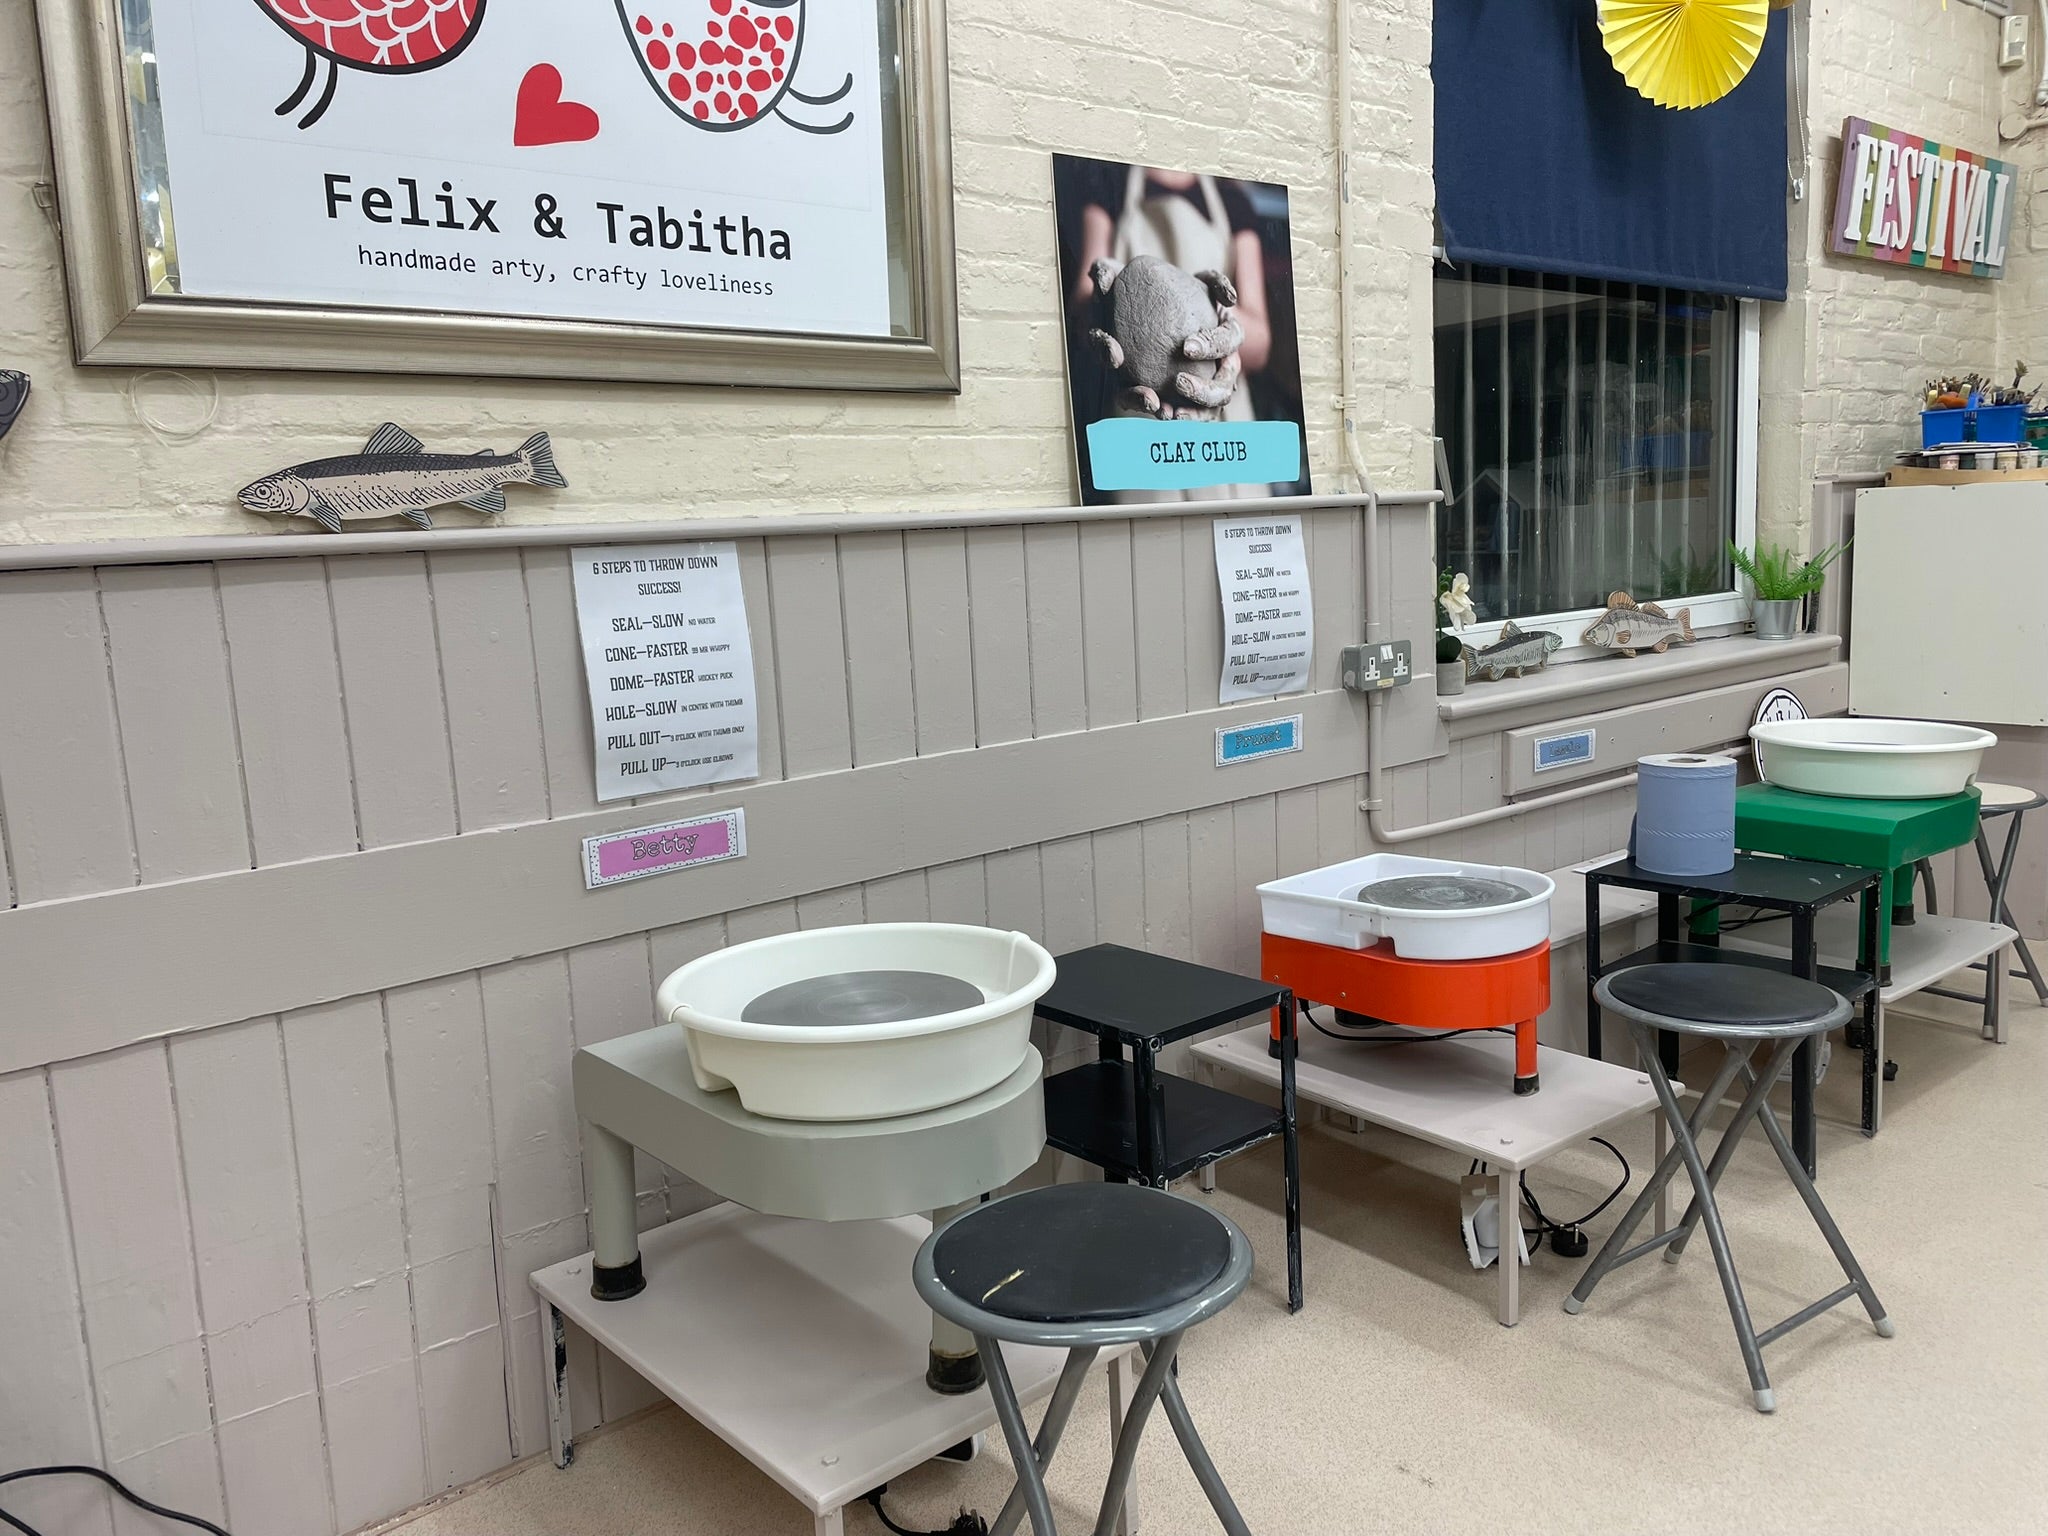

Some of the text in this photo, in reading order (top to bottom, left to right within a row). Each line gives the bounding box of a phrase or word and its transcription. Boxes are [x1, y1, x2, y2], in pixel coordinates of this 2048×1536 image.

[1844, 133, 2010, 266] FESTIVAL
[323, 173, 792, 260] Felix & Tabitha
[358, 244, 774, 296] handmade arty, crafty loveliness
[1150, 441, 1247, 463] CLAY CLUB
[1229, 527, 1246, 539] STEPS
[1246, 527, 1254, 537] TO
[1254, 526, 1275, 537] THROW
[1275, 525, 1292, 535] DOWN
[592, 556, 718, 575] 6 STEPS TO THROW DOWN
[638, 581, 682, 596] SUCCESS!
[608, 734, 636, 750] PULL
[620, 760, 648, 776] PULL
[631, 833, 699, 860] Betty
